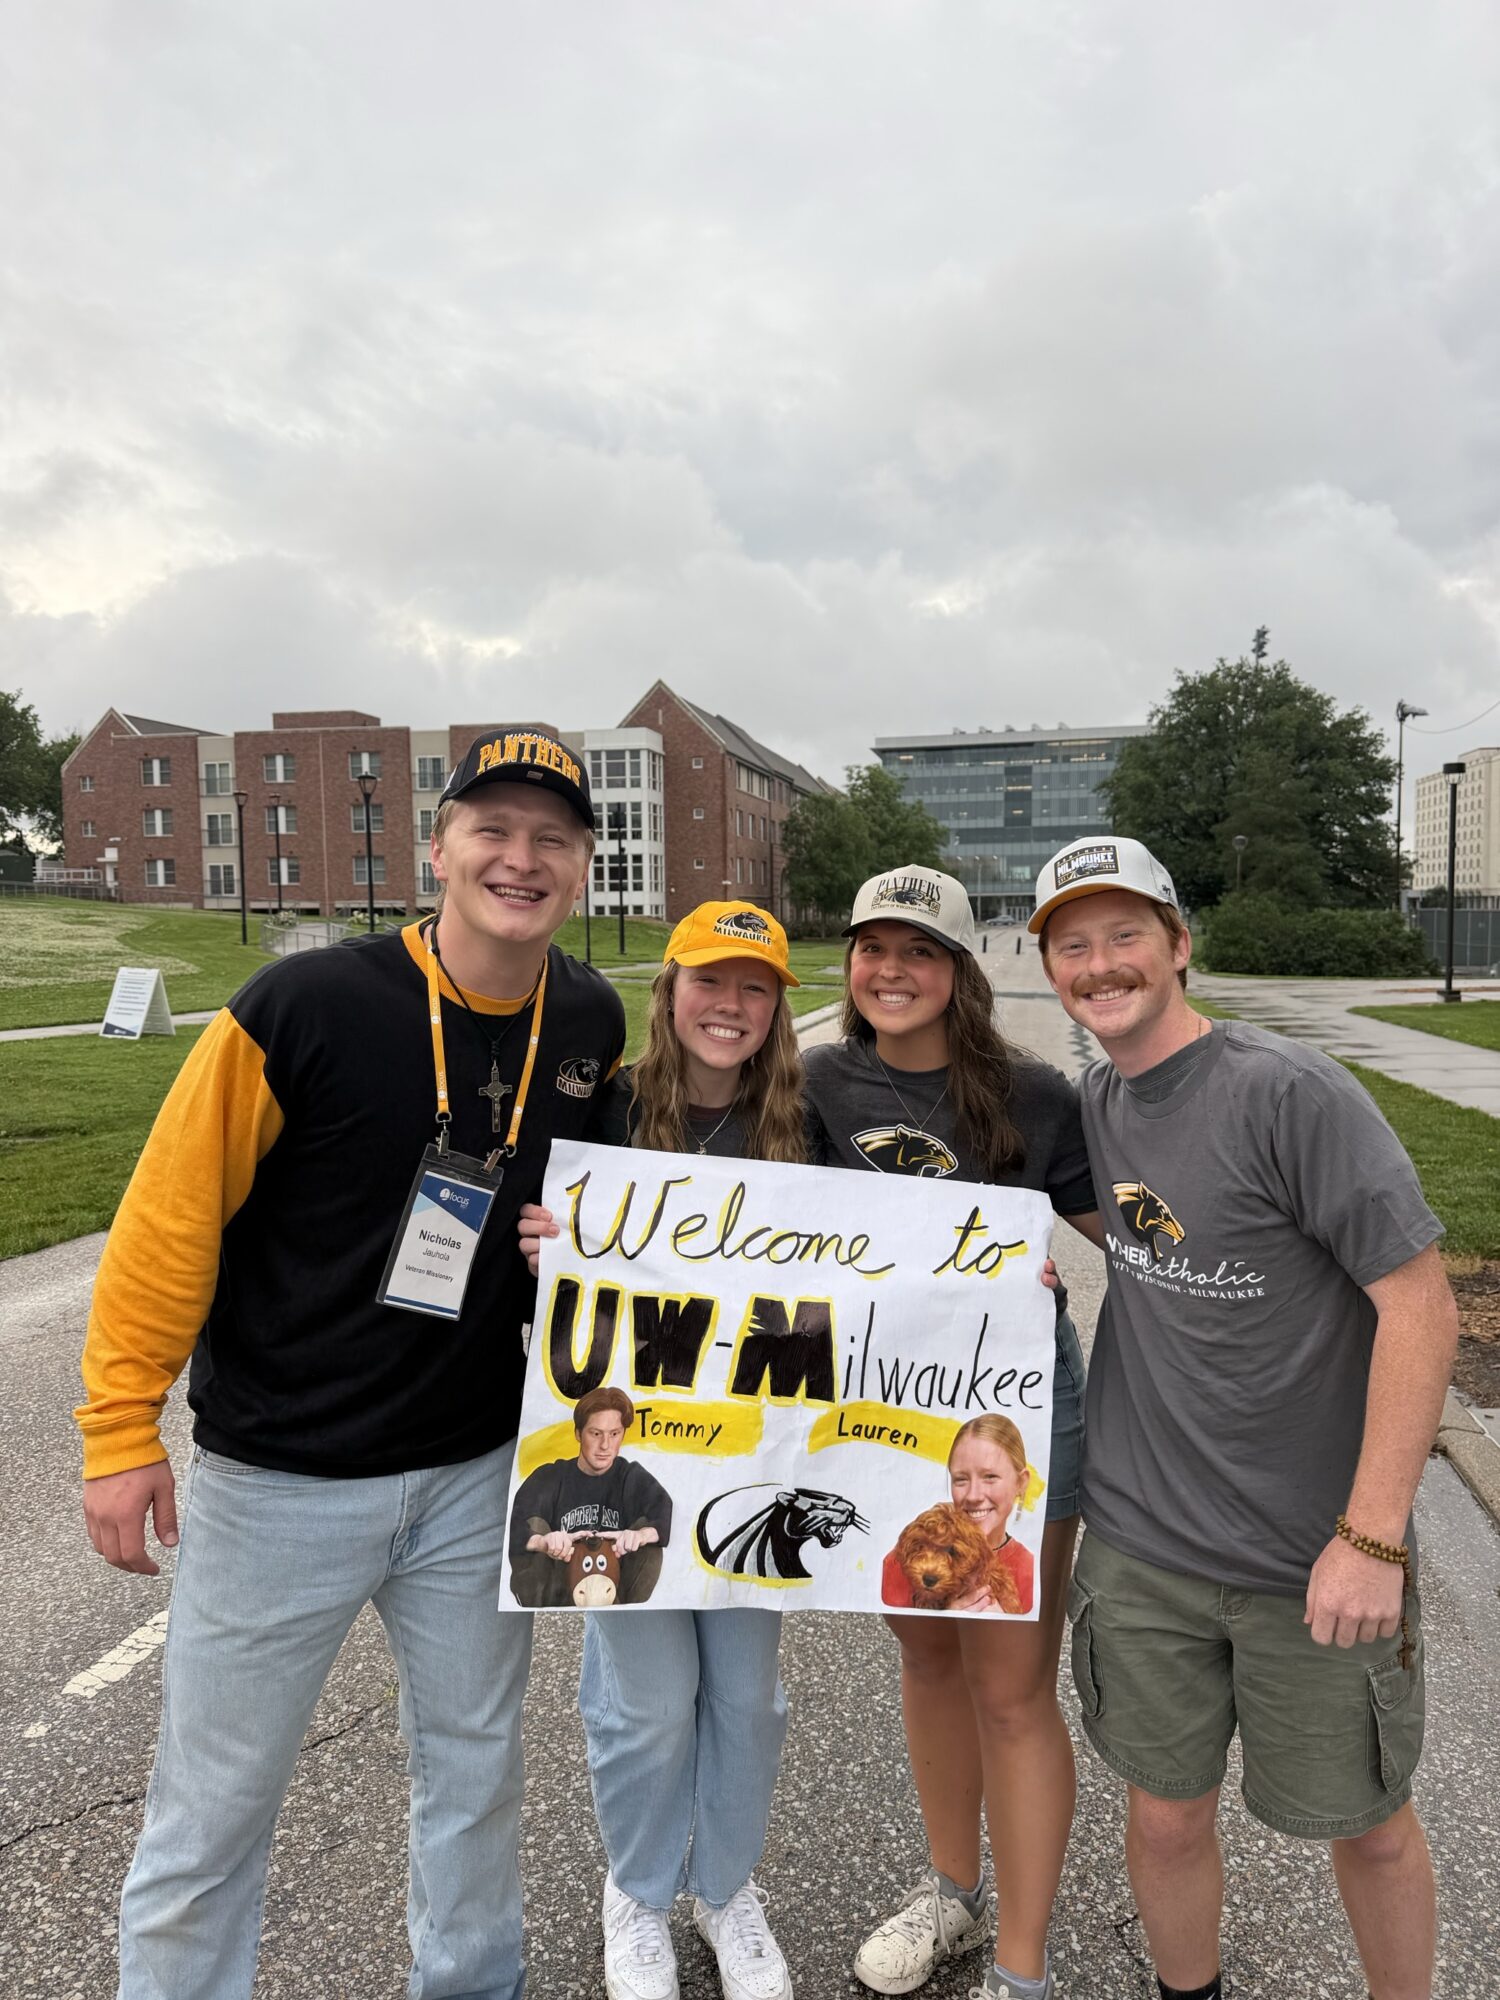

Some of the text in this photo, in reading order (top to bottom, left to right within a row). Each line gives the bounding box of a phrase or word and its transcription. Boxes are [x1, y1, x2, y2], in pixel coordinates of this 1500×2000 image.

[477, 733, 581, 788] PANTHERS
[1057, 851, 1115, 877] MILWAUKEE
[876, 876, 943, 902] PANTHERS
[713, 925, 772, 946] MILWAUKEE
[449, 1189, 470, 1206] focus
[566, 1169, 1026, 1276] Welcome to
[418, 1229, 462, 1250] Nicholas
[405, 1265, 454, 1283] Veteran Missionary
[1136, 1272, 1181, 1293] WISCONSIN
[1189, 1287, 1265, 1300] MILWAUKEE
[549, 1277, 1043, 1410] UW-Milwaukee
[635, 1407, 722, 1452] Tommy
[837, 1411, 918, 1449] Lauren
[560, 1503, 600, 1533] NOTRE
